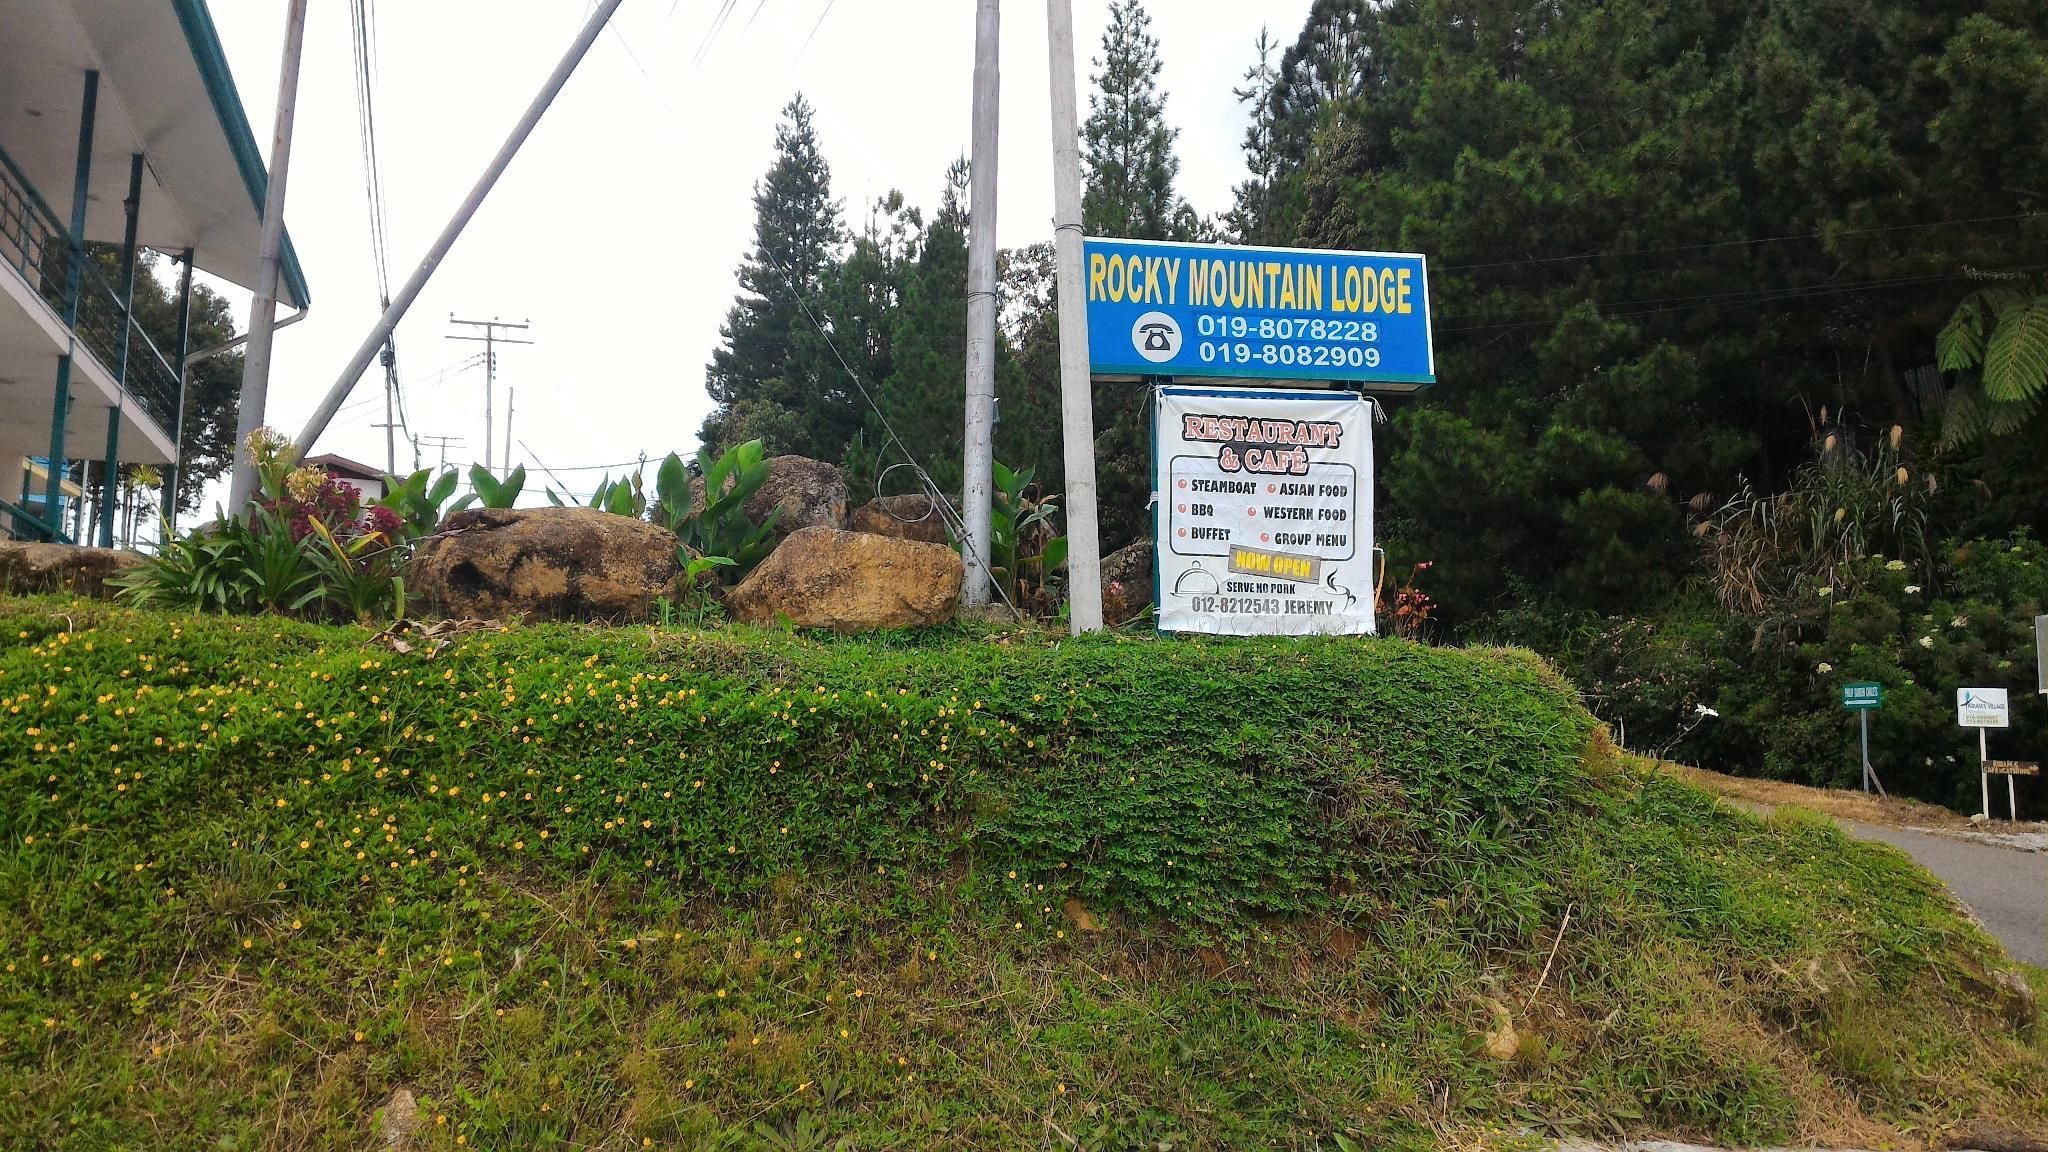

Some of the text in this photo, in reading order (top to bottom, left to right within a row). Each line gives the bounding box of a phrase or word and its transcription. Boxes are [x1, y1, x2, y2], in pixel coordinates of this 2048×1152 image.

[1089, 253, 1412, 314] ROCKY MOUNTAIN LODGE
[1197, 314, 1378, 342] 019-8078228
[1199, 341, 1381, 368] 019-8082909
[1183, 414, 1342, 448] RESTAURANT
[1220, 446, 1308, 473] & CAFÉ
[1191, 479, 1257, 494] STEAMBOAT
[1280, 483, 1348, 497] ASIAN FOOD
[1191, 504, 1214, 516] BBQ
[1264, 507, 1347, 521] WESTERN FOOD
[1191, 527, 1231, 541] BUFFET
[1275, 532, 1347, 546] GROUP MENU
[1235, 550, 1312, 577] NOW OPEN
[1226, 581, 1296, 594] SERVE NO PORK
[1191, 596, 1334, 615] 012-8212543 JEREMY
